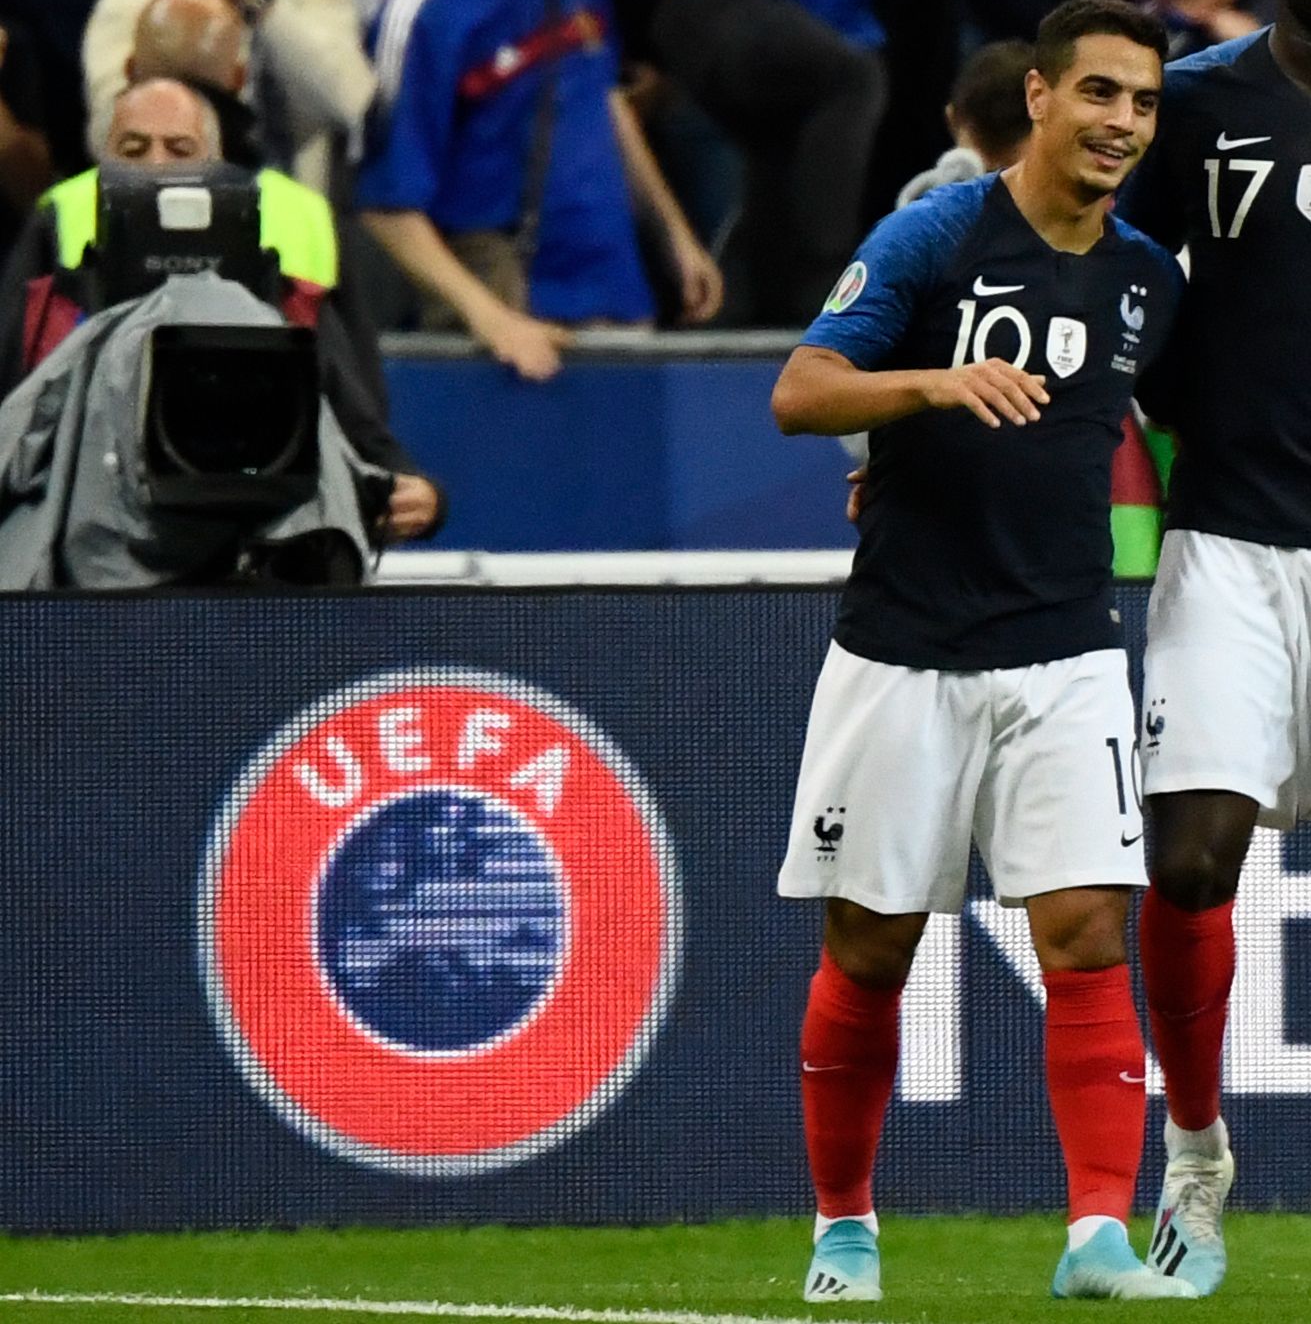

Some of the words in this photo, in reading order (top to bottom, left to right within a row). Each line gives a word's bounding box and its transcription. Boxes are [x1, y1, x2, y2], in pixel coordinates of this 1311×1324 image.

[1204, 159, 1275, 238] 17
[952, 299, 1031, 371] 10
[294, 706, 573, 818] UEFA
